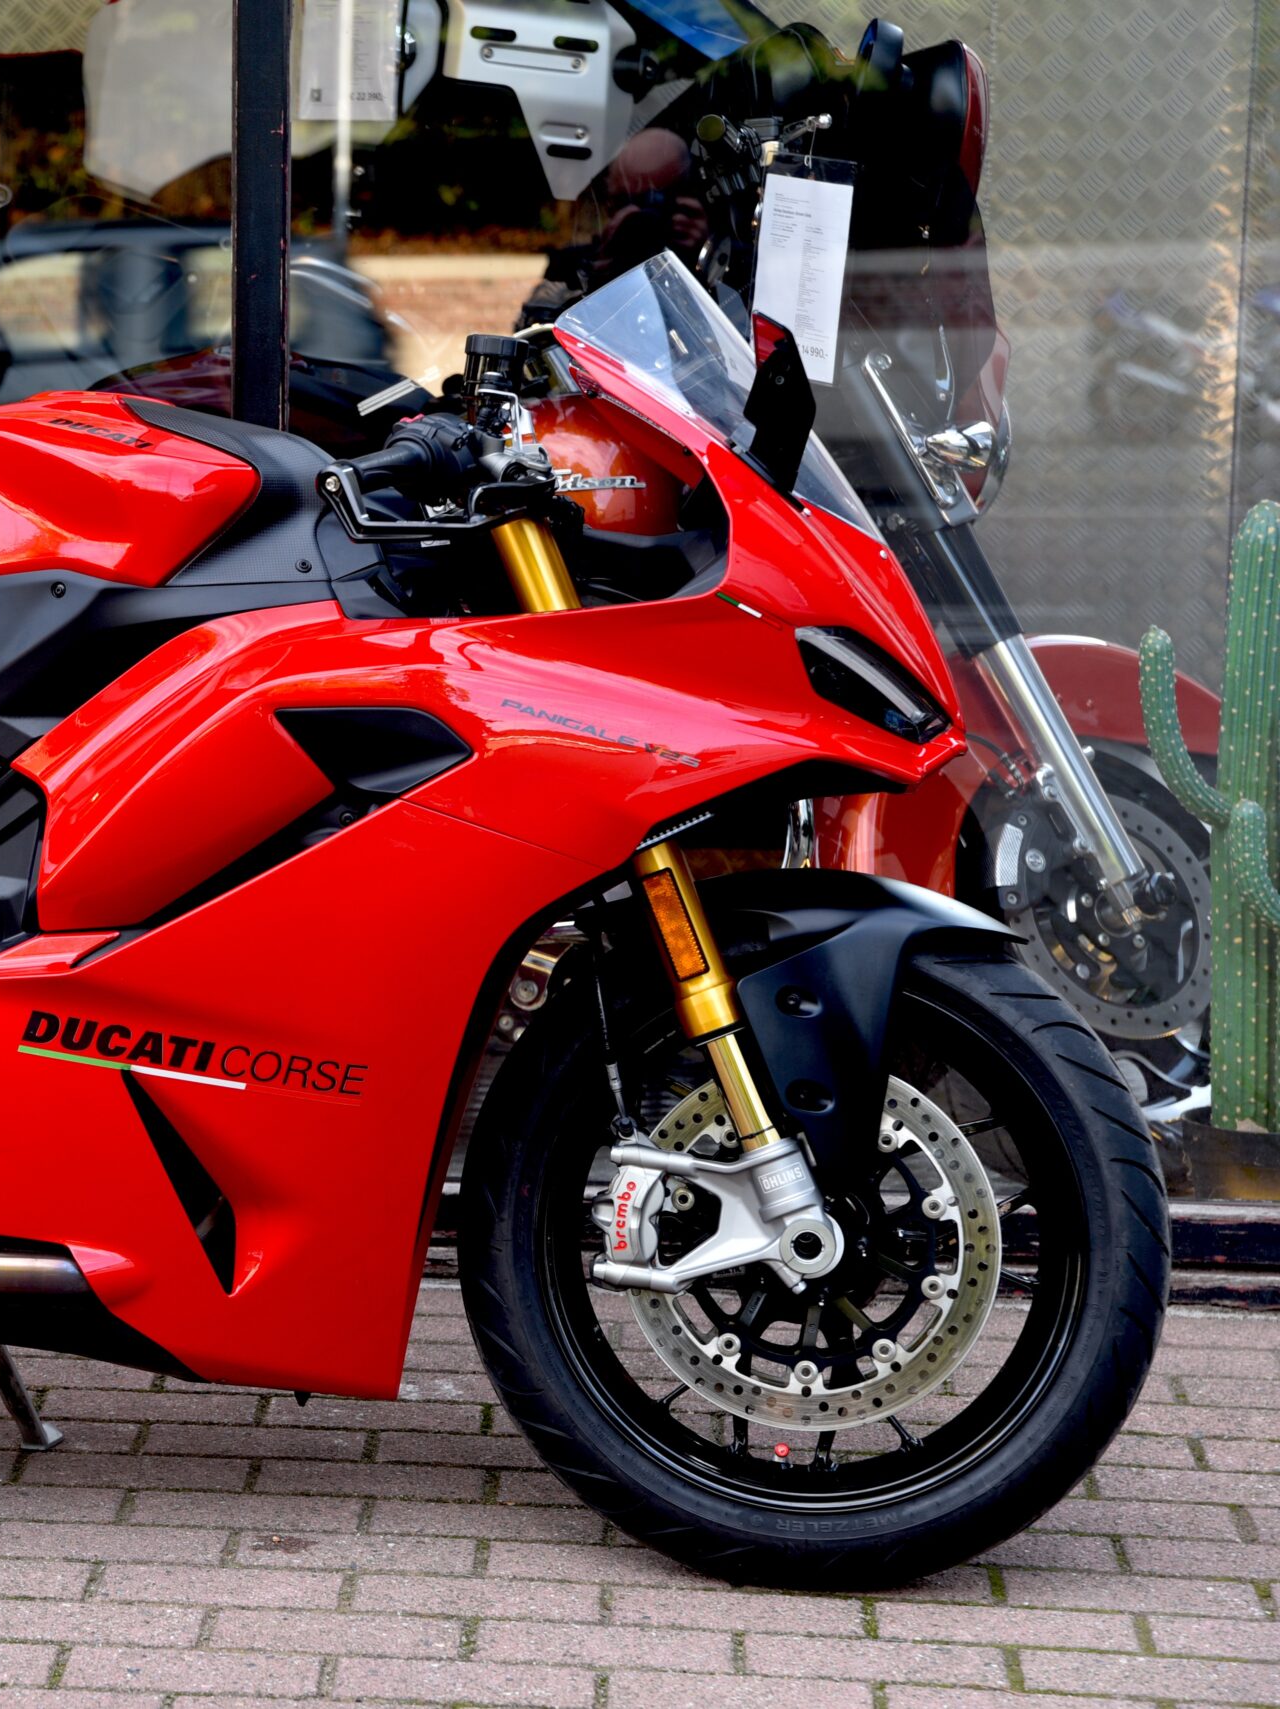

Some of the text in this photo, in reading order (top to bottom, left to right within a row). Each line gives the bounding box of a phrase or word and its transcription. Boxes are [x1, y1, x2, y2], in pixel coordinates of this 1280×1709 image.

[500, 698, 701, 768] PANIGALE V2S
[21, 1010, 369, 1096] DUCATI CORSE
[614, 1181, 637, 1251] brembo
[775, 1511, 900, 1533] METZELER
